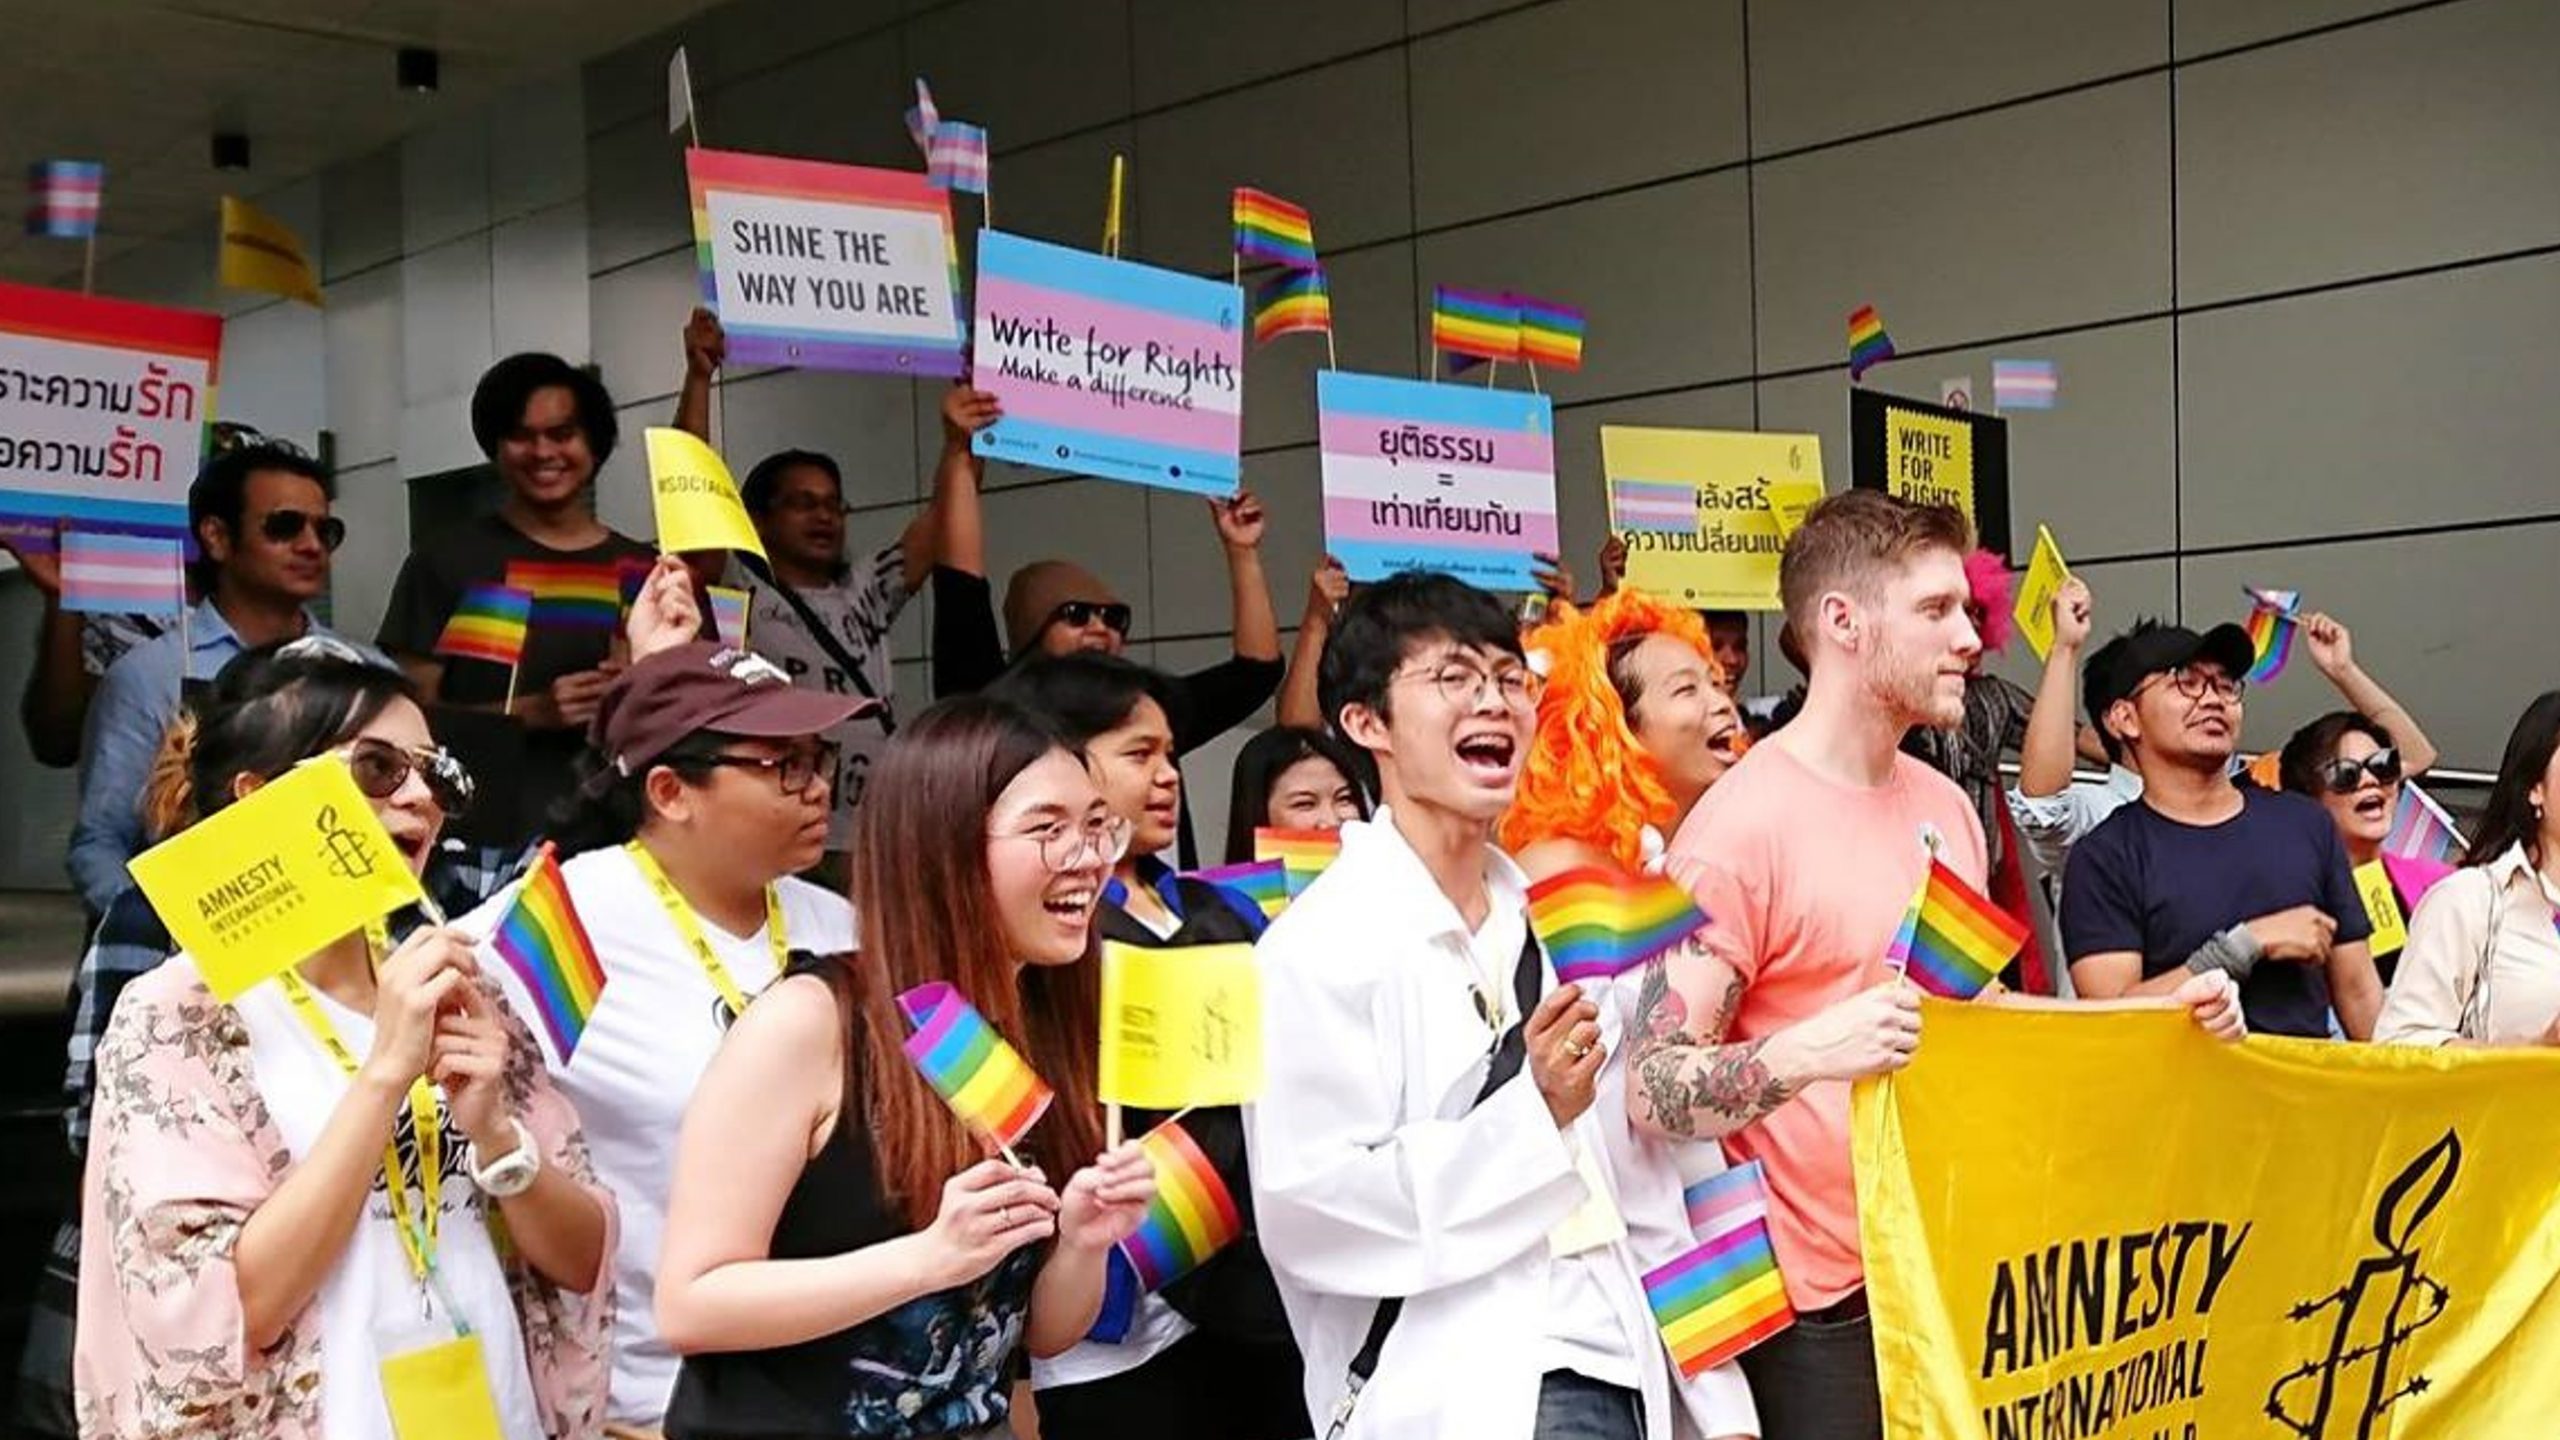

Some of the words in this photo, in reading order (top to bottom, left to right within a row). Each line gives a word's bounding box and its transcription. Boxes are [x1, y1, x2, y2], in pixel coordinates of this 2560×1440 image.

[732, 219, 825, 260] SHINE
[833, 229, 891, 266] THE
[737, 270, 797, 307] WAY
[807, 276, 866, 312] YOU
[875, 282, 931, 317] ARE
[990, 311, 1073, 356] Write
[1084, 326, 1135, 376] for
[1144, 341, 1236, 395] Rights
[999, 355, 1060, 386] Make
[1066, 373, 1083, 391] a
[1089, 373, 1195, 412] difference
[1379, 424, 1494, 467] ยุติธรรม
[1898, 426, 1952, 460] WRITE
[1900, 455, 1934, 485] FOR
[1371, 493, 1522, 536] เท่าเทียมกัน
[1901, 481, 1962, 510] RIGHTS
[197, 853, 284, 920] AMNESTY
[1982, 1220, 2253, 1379] AMNESTY
[1982, 1338, 2207, 1440] INTERNATIONAL
